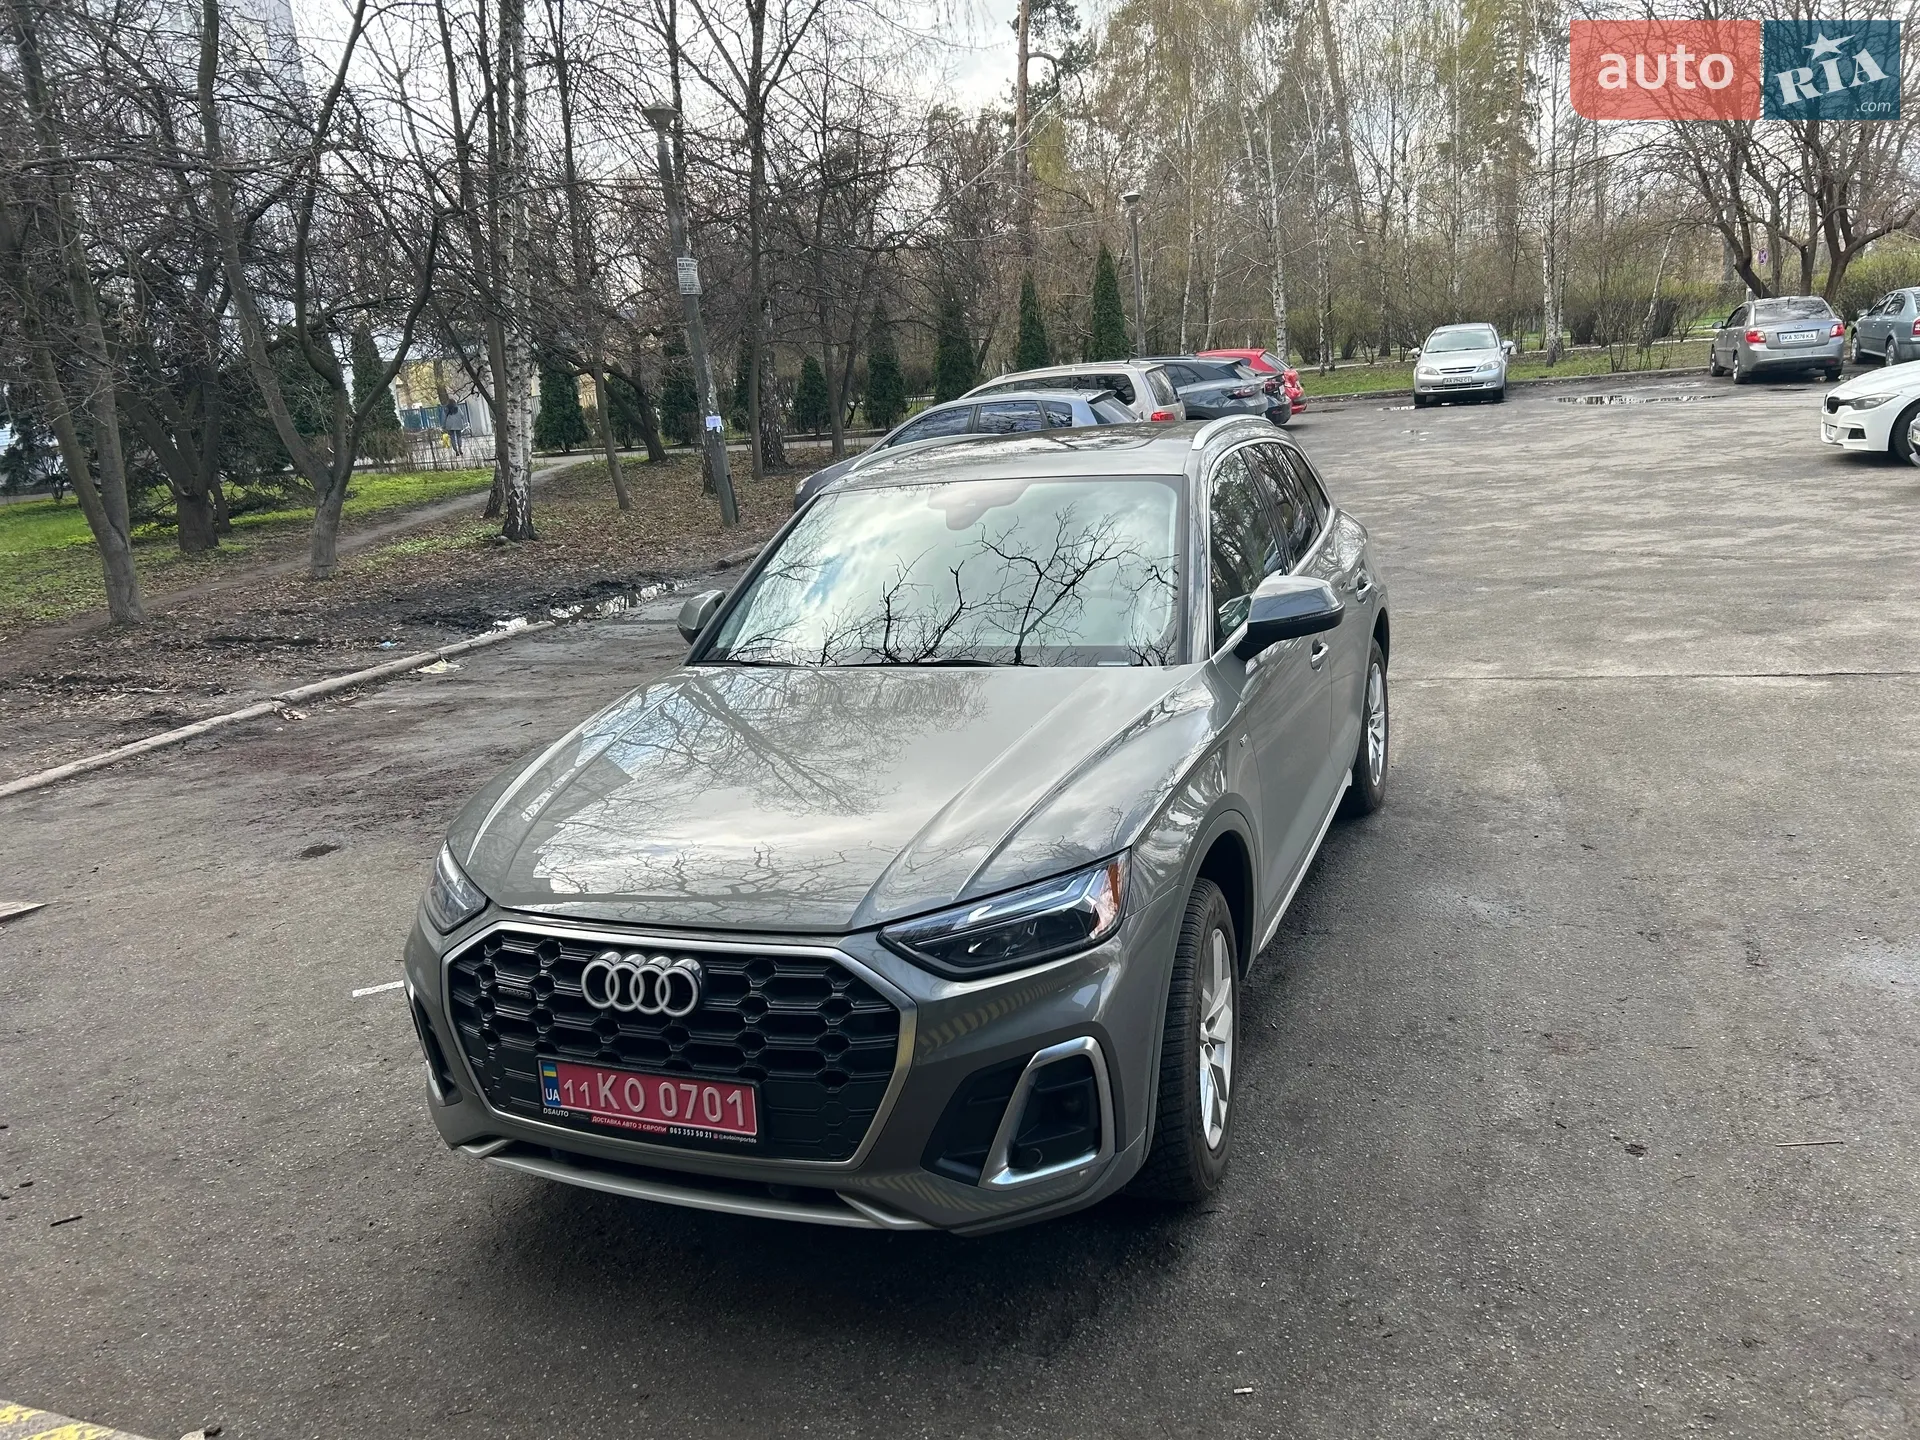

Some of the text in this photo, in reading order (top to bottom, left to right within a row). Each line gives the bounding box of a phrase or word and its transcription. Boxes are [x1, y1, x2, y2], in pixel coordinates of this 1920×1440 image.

[545, 1087, 561, 1102] UA
[543, 1107, 569, 1117] DSAUTO
[658, 1082, 745, 1127] 0701
[592, 1115, 621, 1126] ДОСТАВКА
[621, 1120, 637, 1129] АВТО
[642, 1123, 667, 1133] ЄВРОПИ
[669, 1126, 682, 1135] 063
[683, 1128, 695, 1136] 353
[704, 1131, 712, 1139] 21
